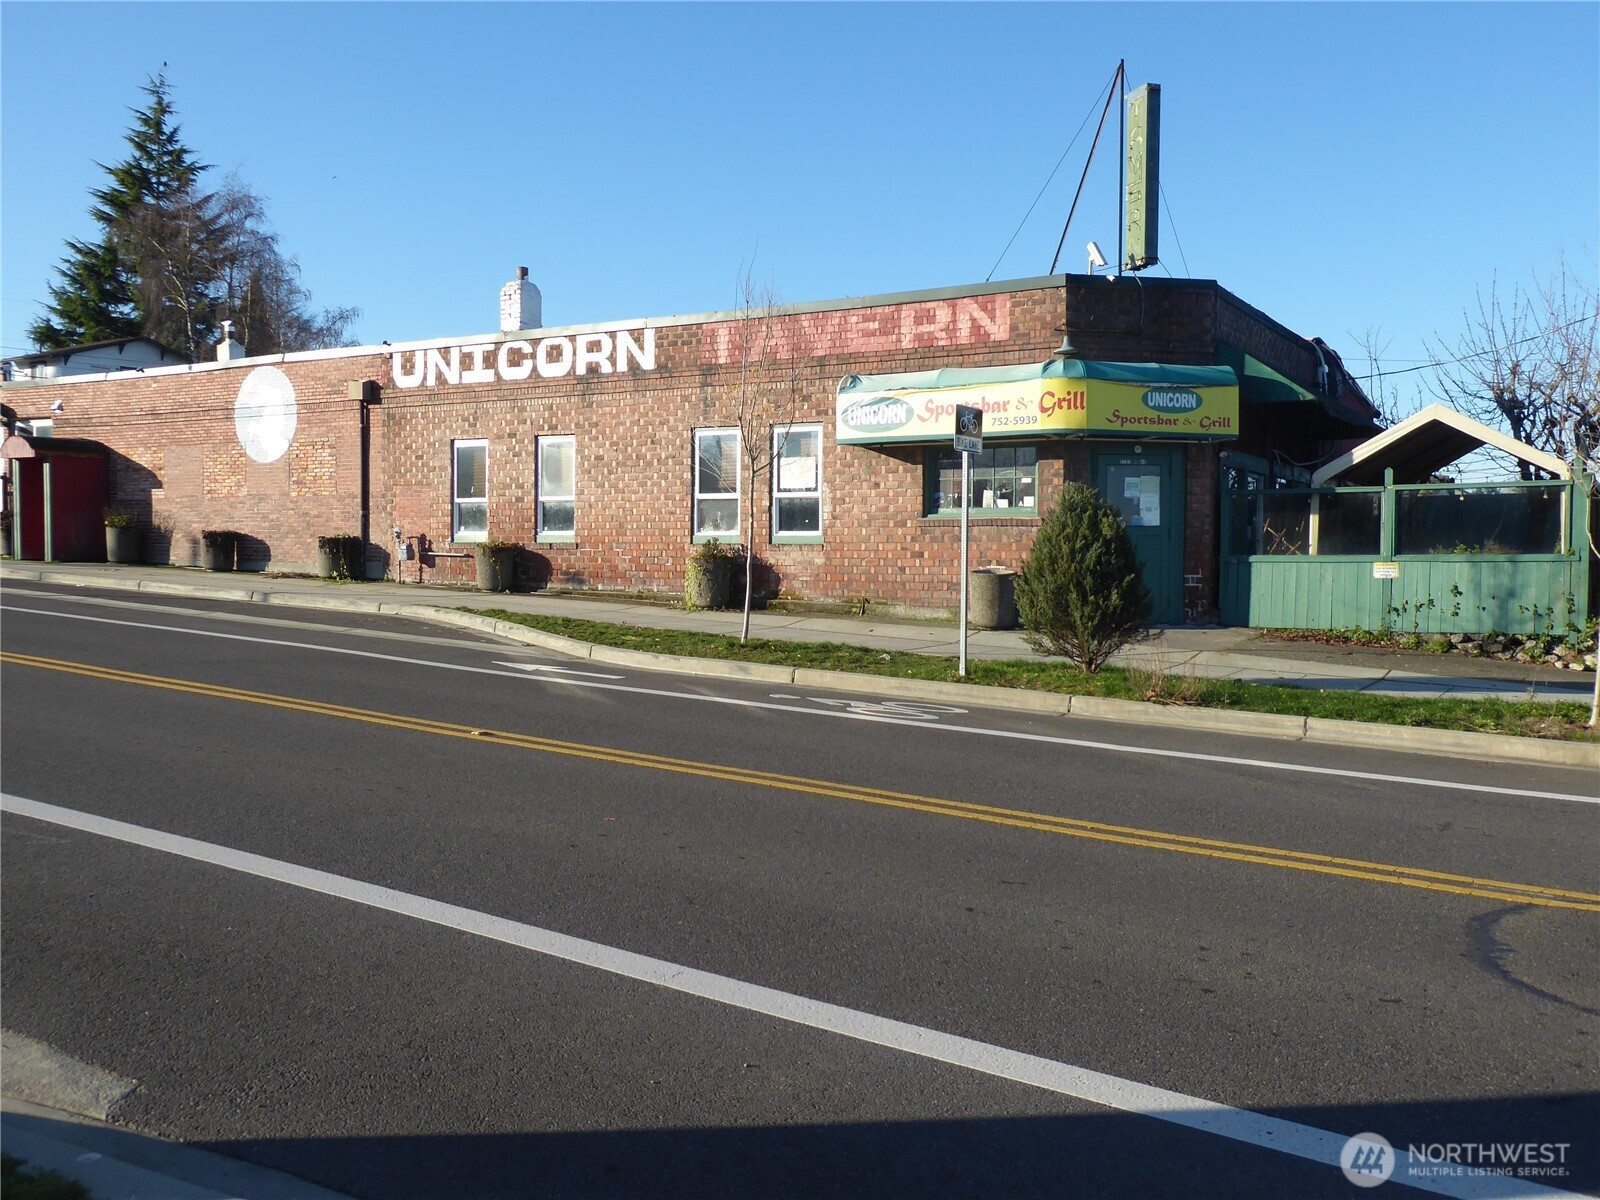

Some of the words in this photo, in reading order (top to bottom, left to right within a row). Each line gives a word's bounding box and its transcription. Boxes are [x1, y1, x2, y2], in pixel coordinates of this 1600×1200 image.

[392, 327, 656, 389] UNICORN
[847, 403, 907, 426] UNICORN
[916, 395, 1010, 423] Spobar
[1015, 397, 1034, 410] &
[1038, 390, 1085, 417] Grill
[1147, 391, 1197, 408] UNICORN
[991, 415, 1038, 426] 752-5939
[1105, 409, 1179, 427] Sportsbar
[1182, 417, 1196, 426] &
[1199, 415, 1231, 431] Grill
